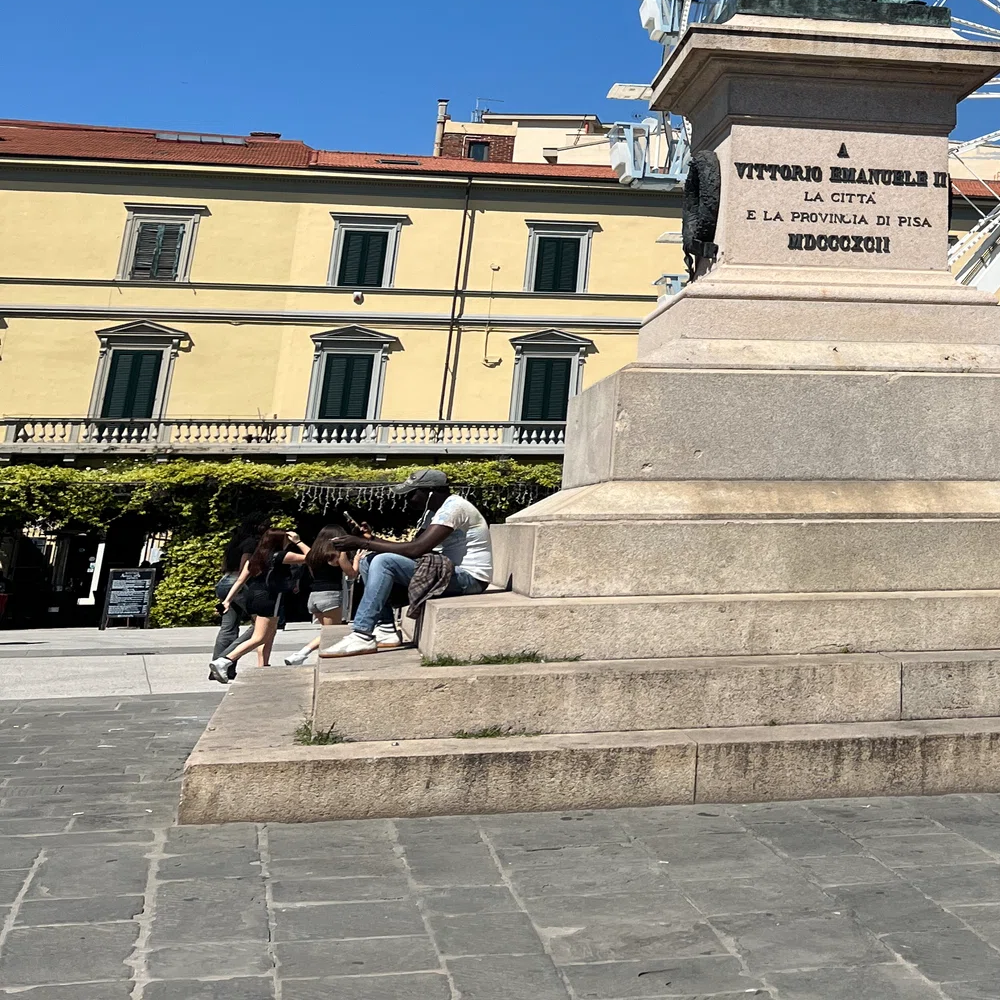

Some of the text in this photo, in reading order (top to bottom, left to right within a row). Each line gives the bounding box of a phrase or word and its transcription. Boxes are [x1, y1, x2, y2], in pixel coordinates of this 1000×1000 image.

[837, 142, 850, 158] A
[734, 162, 823, 183] VITTORIO
[829, 166, 928, 187] EMANUELE
[804, 191, 824, 203] LA
[747, 210, 932, 228] E LA PROVINCIA DI PISA
[788, 233, 891, 254] MDCCCXCII
